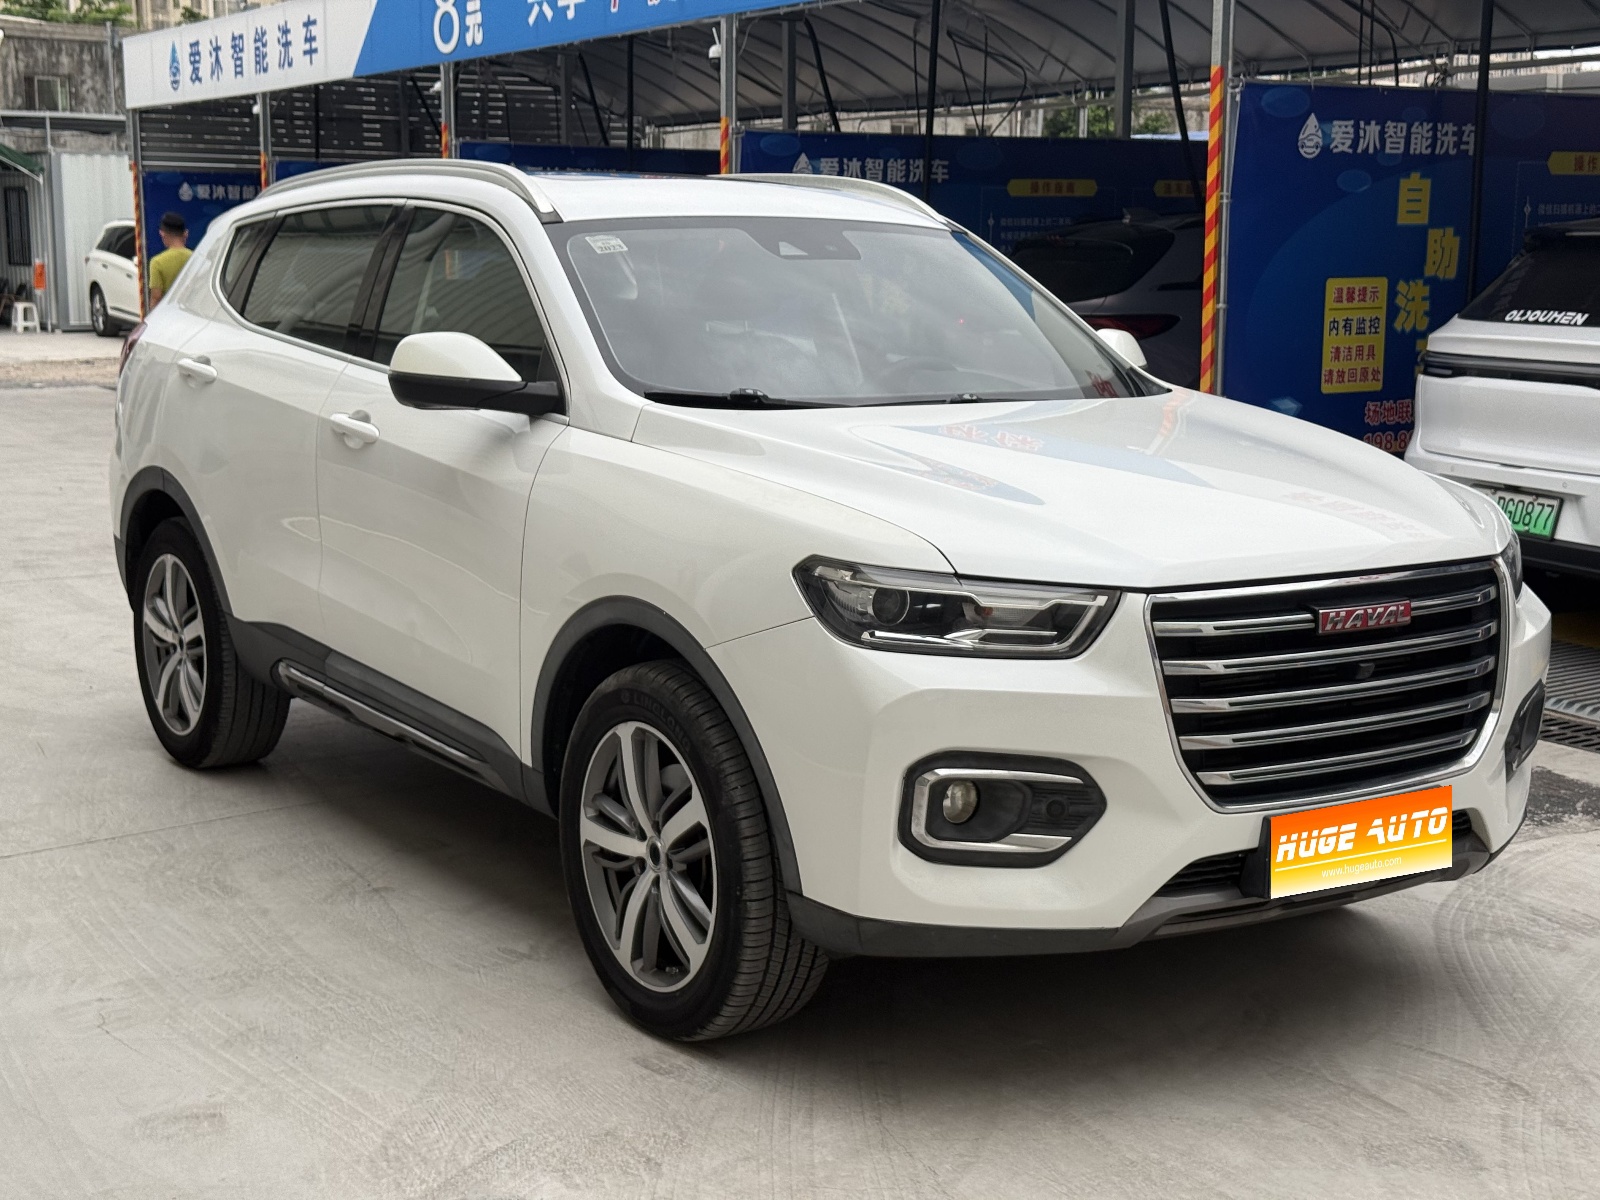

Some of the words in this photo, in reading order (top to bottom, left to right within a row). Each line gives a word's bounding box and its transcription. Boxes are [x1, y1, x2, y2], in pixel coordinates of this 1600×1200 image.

[188, 14, 318, 86] 爱沐智能洗车
[1333, 286, 1380, 303] 温馨提示
[1329, 316, 1380, 336] 内有监控
[1330, 344, 1376, 362] 清洁用具
[1323, 366, 1381, 385] 请放回原处
[1398, 430, 1413, 451] 8
[1324, 604, 1411, 631] HAVAL
